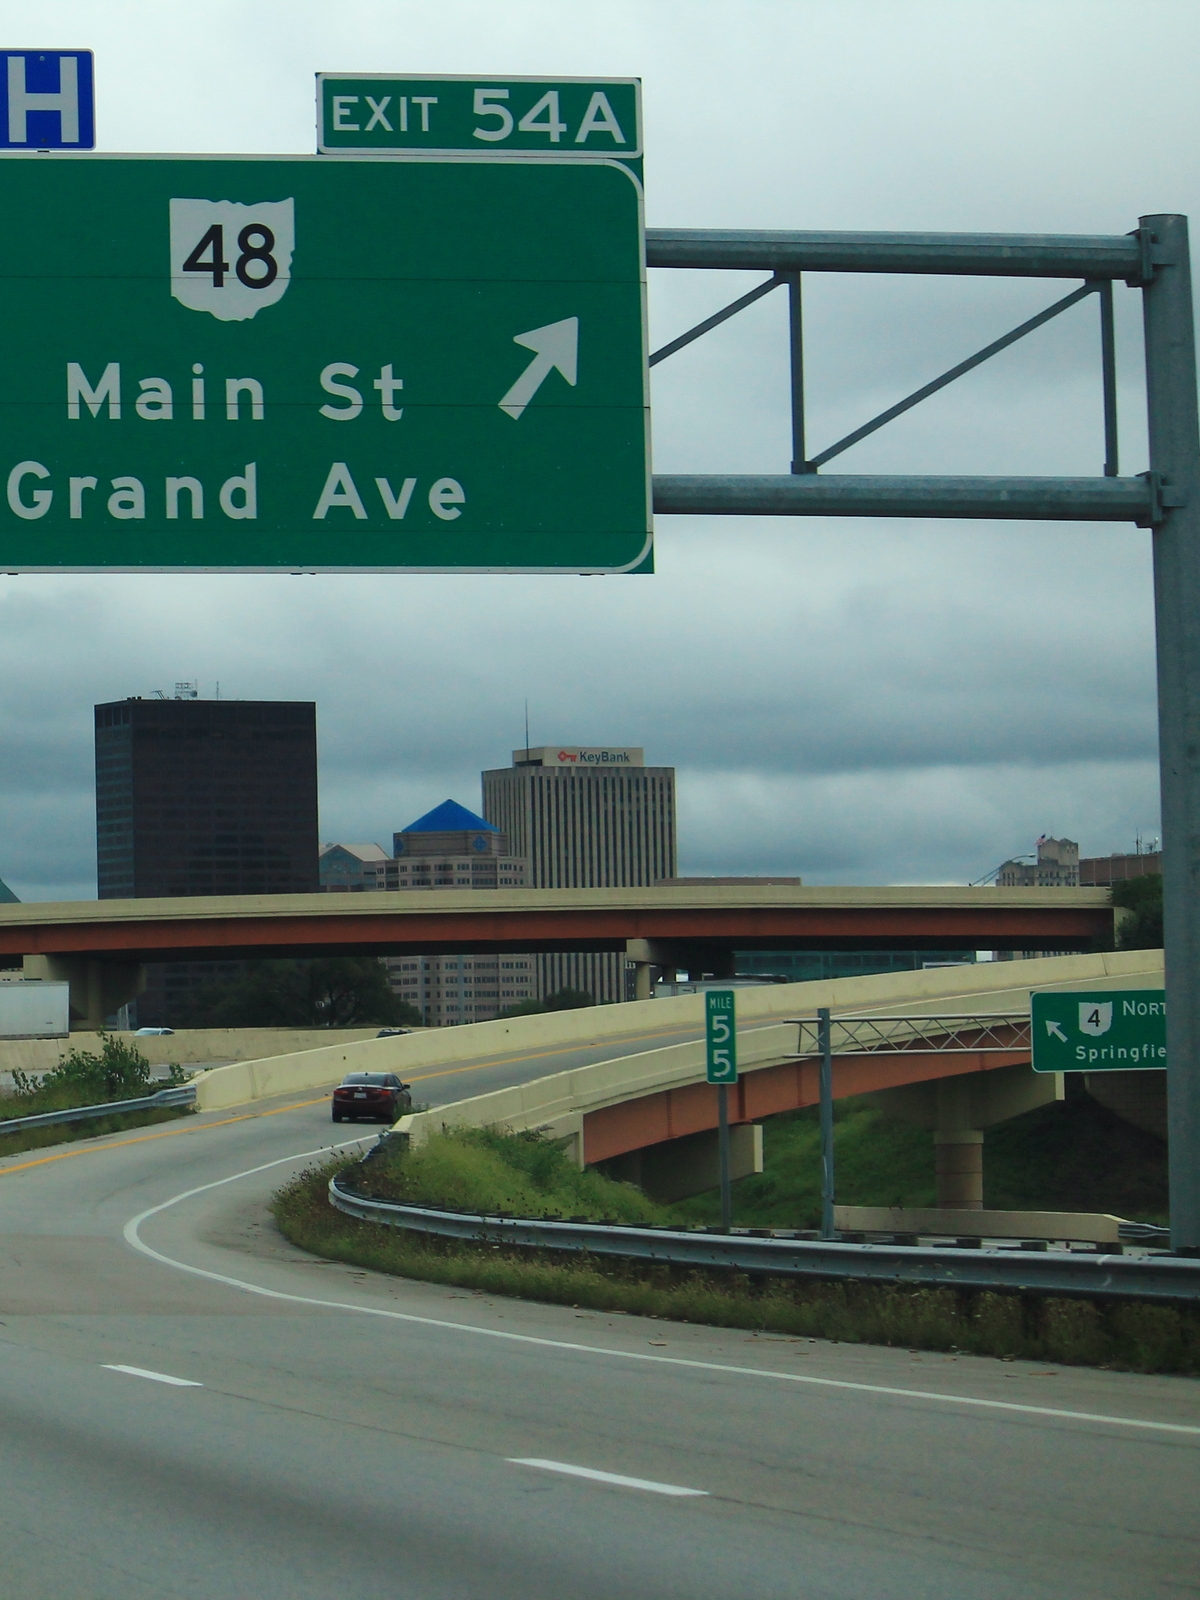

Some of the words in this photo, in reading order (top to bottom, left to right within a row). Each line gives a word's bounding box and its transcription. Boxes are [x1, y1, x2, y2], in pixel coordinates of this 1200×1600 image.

[7, 56, 80, 143] H
[332, 95, 438, 132] EXIT
[472, 88, 627, 145] 54A
[182, 222, 279, 290] 48
[66, 362, 264, 421] Main
[318, 362, 404, 421] St
[6, 460, 258, 520] Grand
[312, 462, 466, 521] Ave
[580, 751, 630, 764] KeyBank
[709, 997, 732, 1009] MILE
[1087, 1009, 1101, 1028] 4
[1122, 1000, 1166, 1016] NORT
[1075, 1044, 1166, 1063] Springfie
